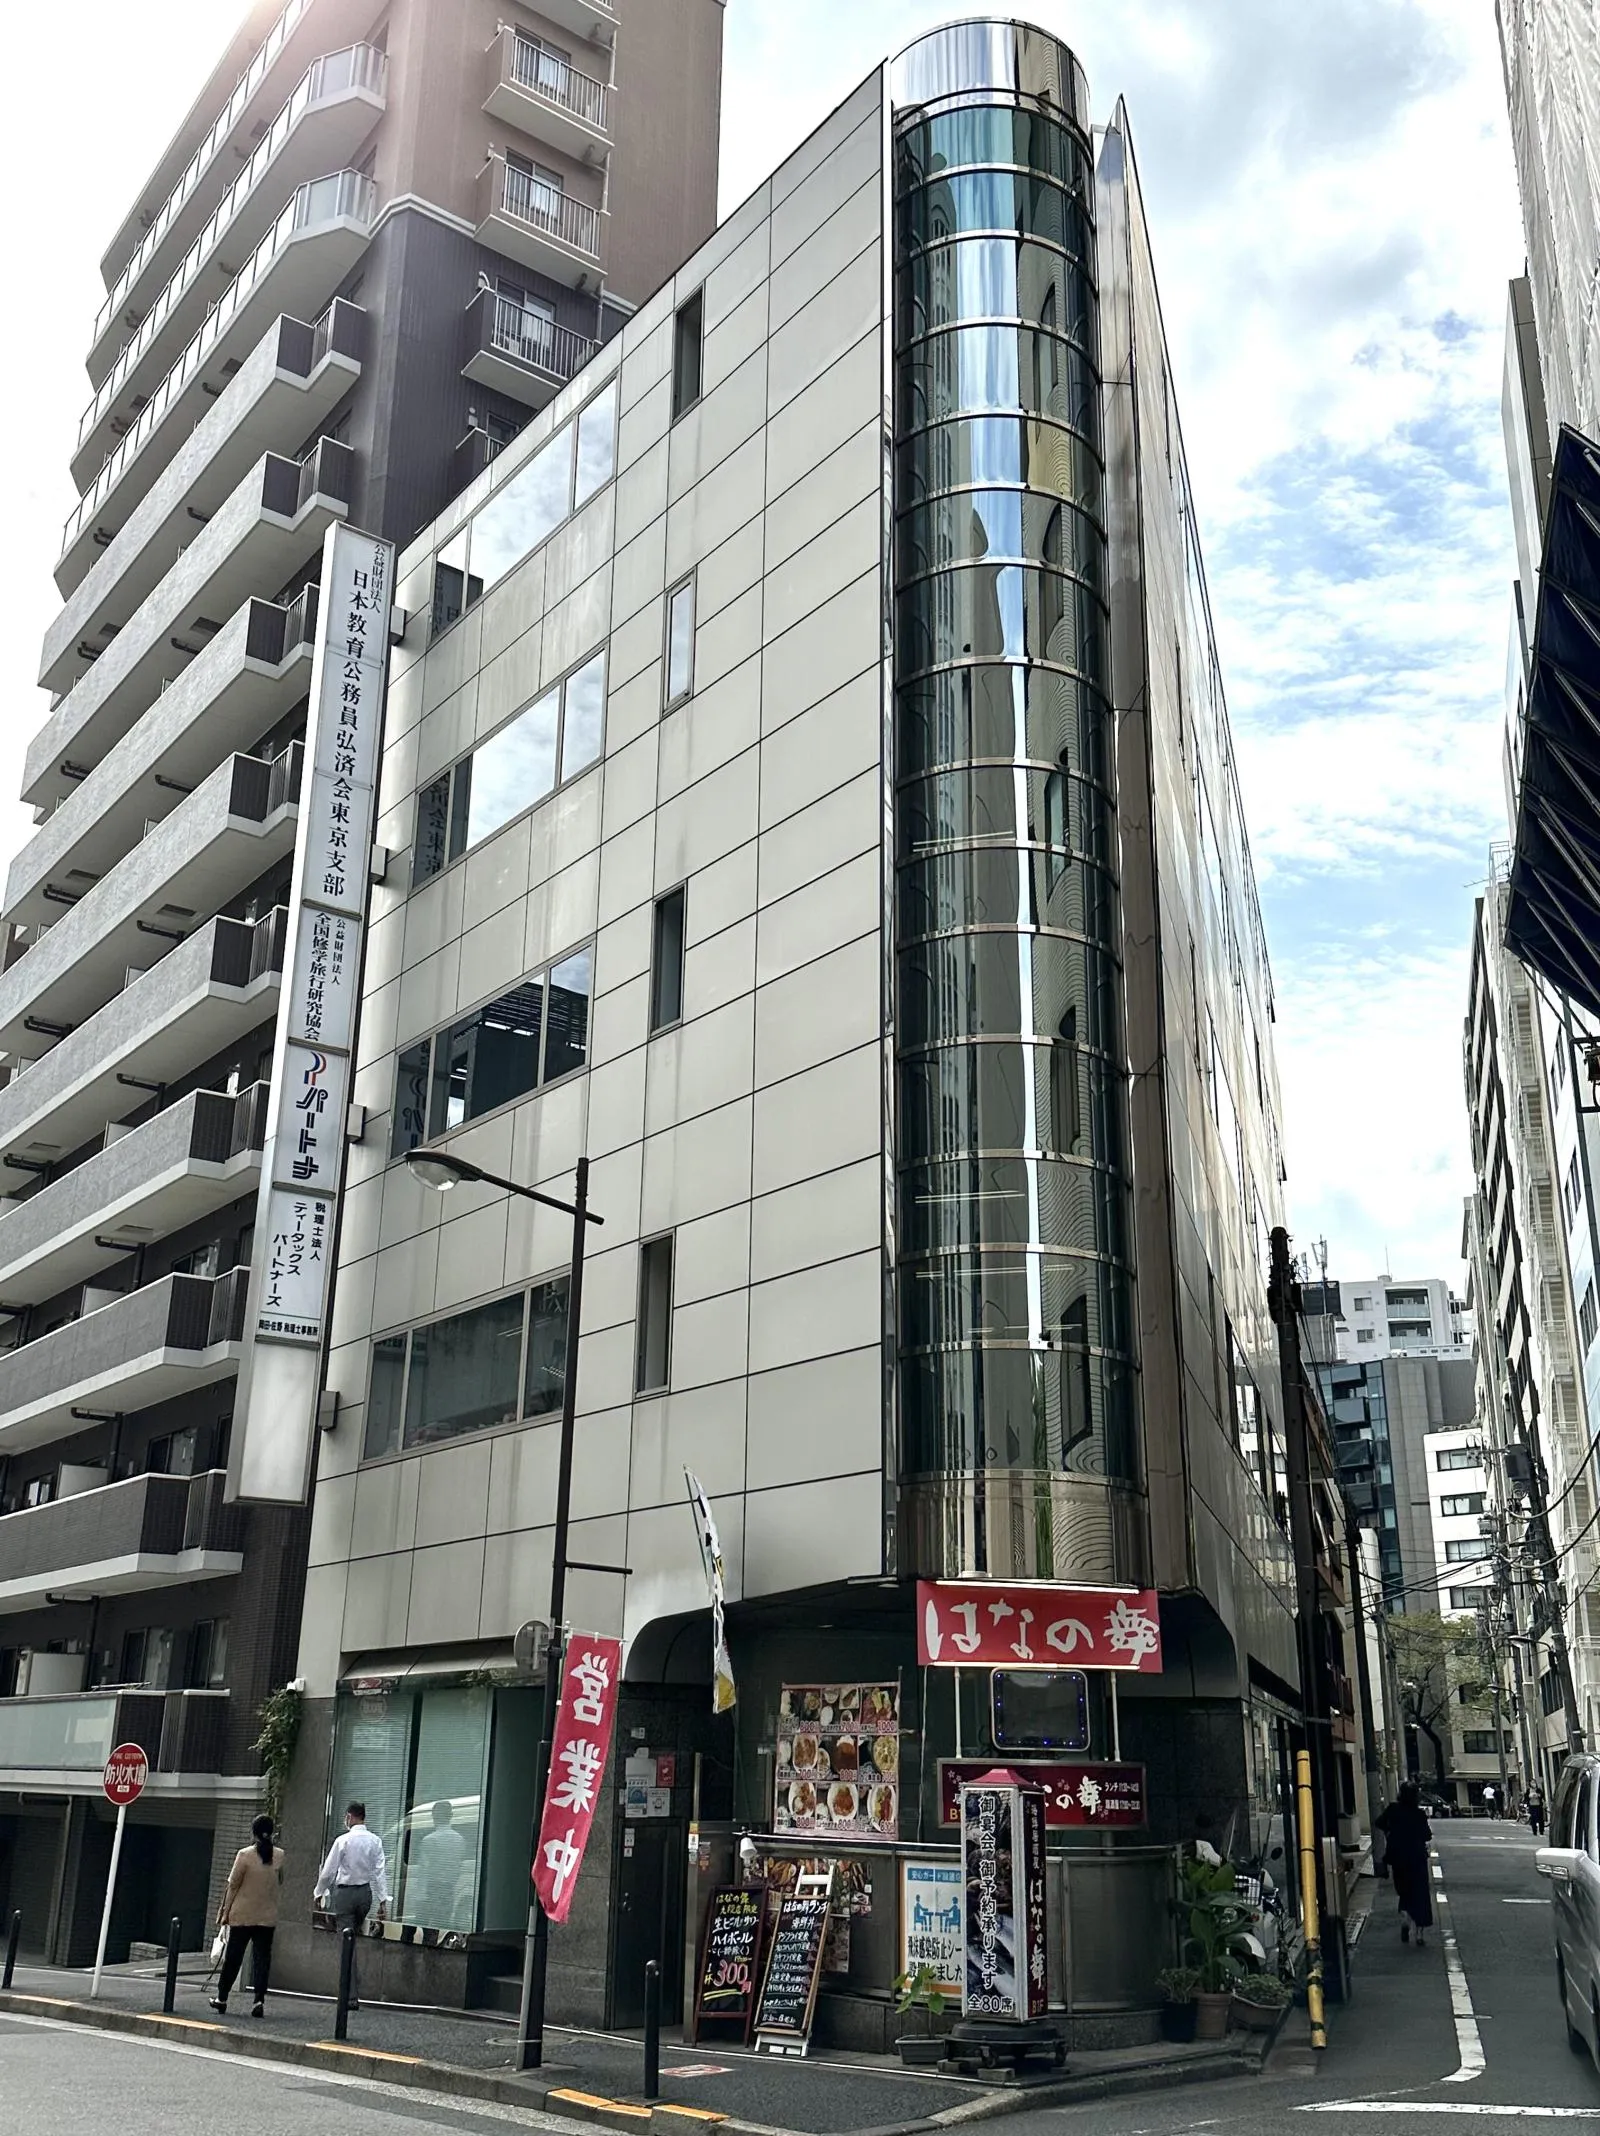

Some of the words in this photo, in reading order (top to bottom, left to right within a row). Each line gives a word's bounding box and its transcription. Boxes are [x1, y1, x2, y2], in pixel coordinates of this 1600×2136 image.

[370, 543, 386, 613] 公益財団法人
[323, 569, 368, 897] 日本教育公務員弘済会東京支部
[305, 913, 331, 1041] 全国修学旅行研究協会
[331, 919, 346, 985] 公益財団法人
[287, 1202, 308, 1276] ティータックス
[310, 1202, 326, 1261] 税理士法人
[266, 1233, 288, 1306] パートナーズ
[925, 1598, 1160, 1665] はなの舞
[104, 1763, 146, 1785] 防火水槽
[544, 1652, 609, 1903] 営業中
[979, 1796, 997, 1989] 御宴会、御予約承ります
[712, 1930, 753, 1946] ハイボール
[1029, 1879, 1046, 1990] はなの舞
[968, 1995, 1015, 2013] 全80席
